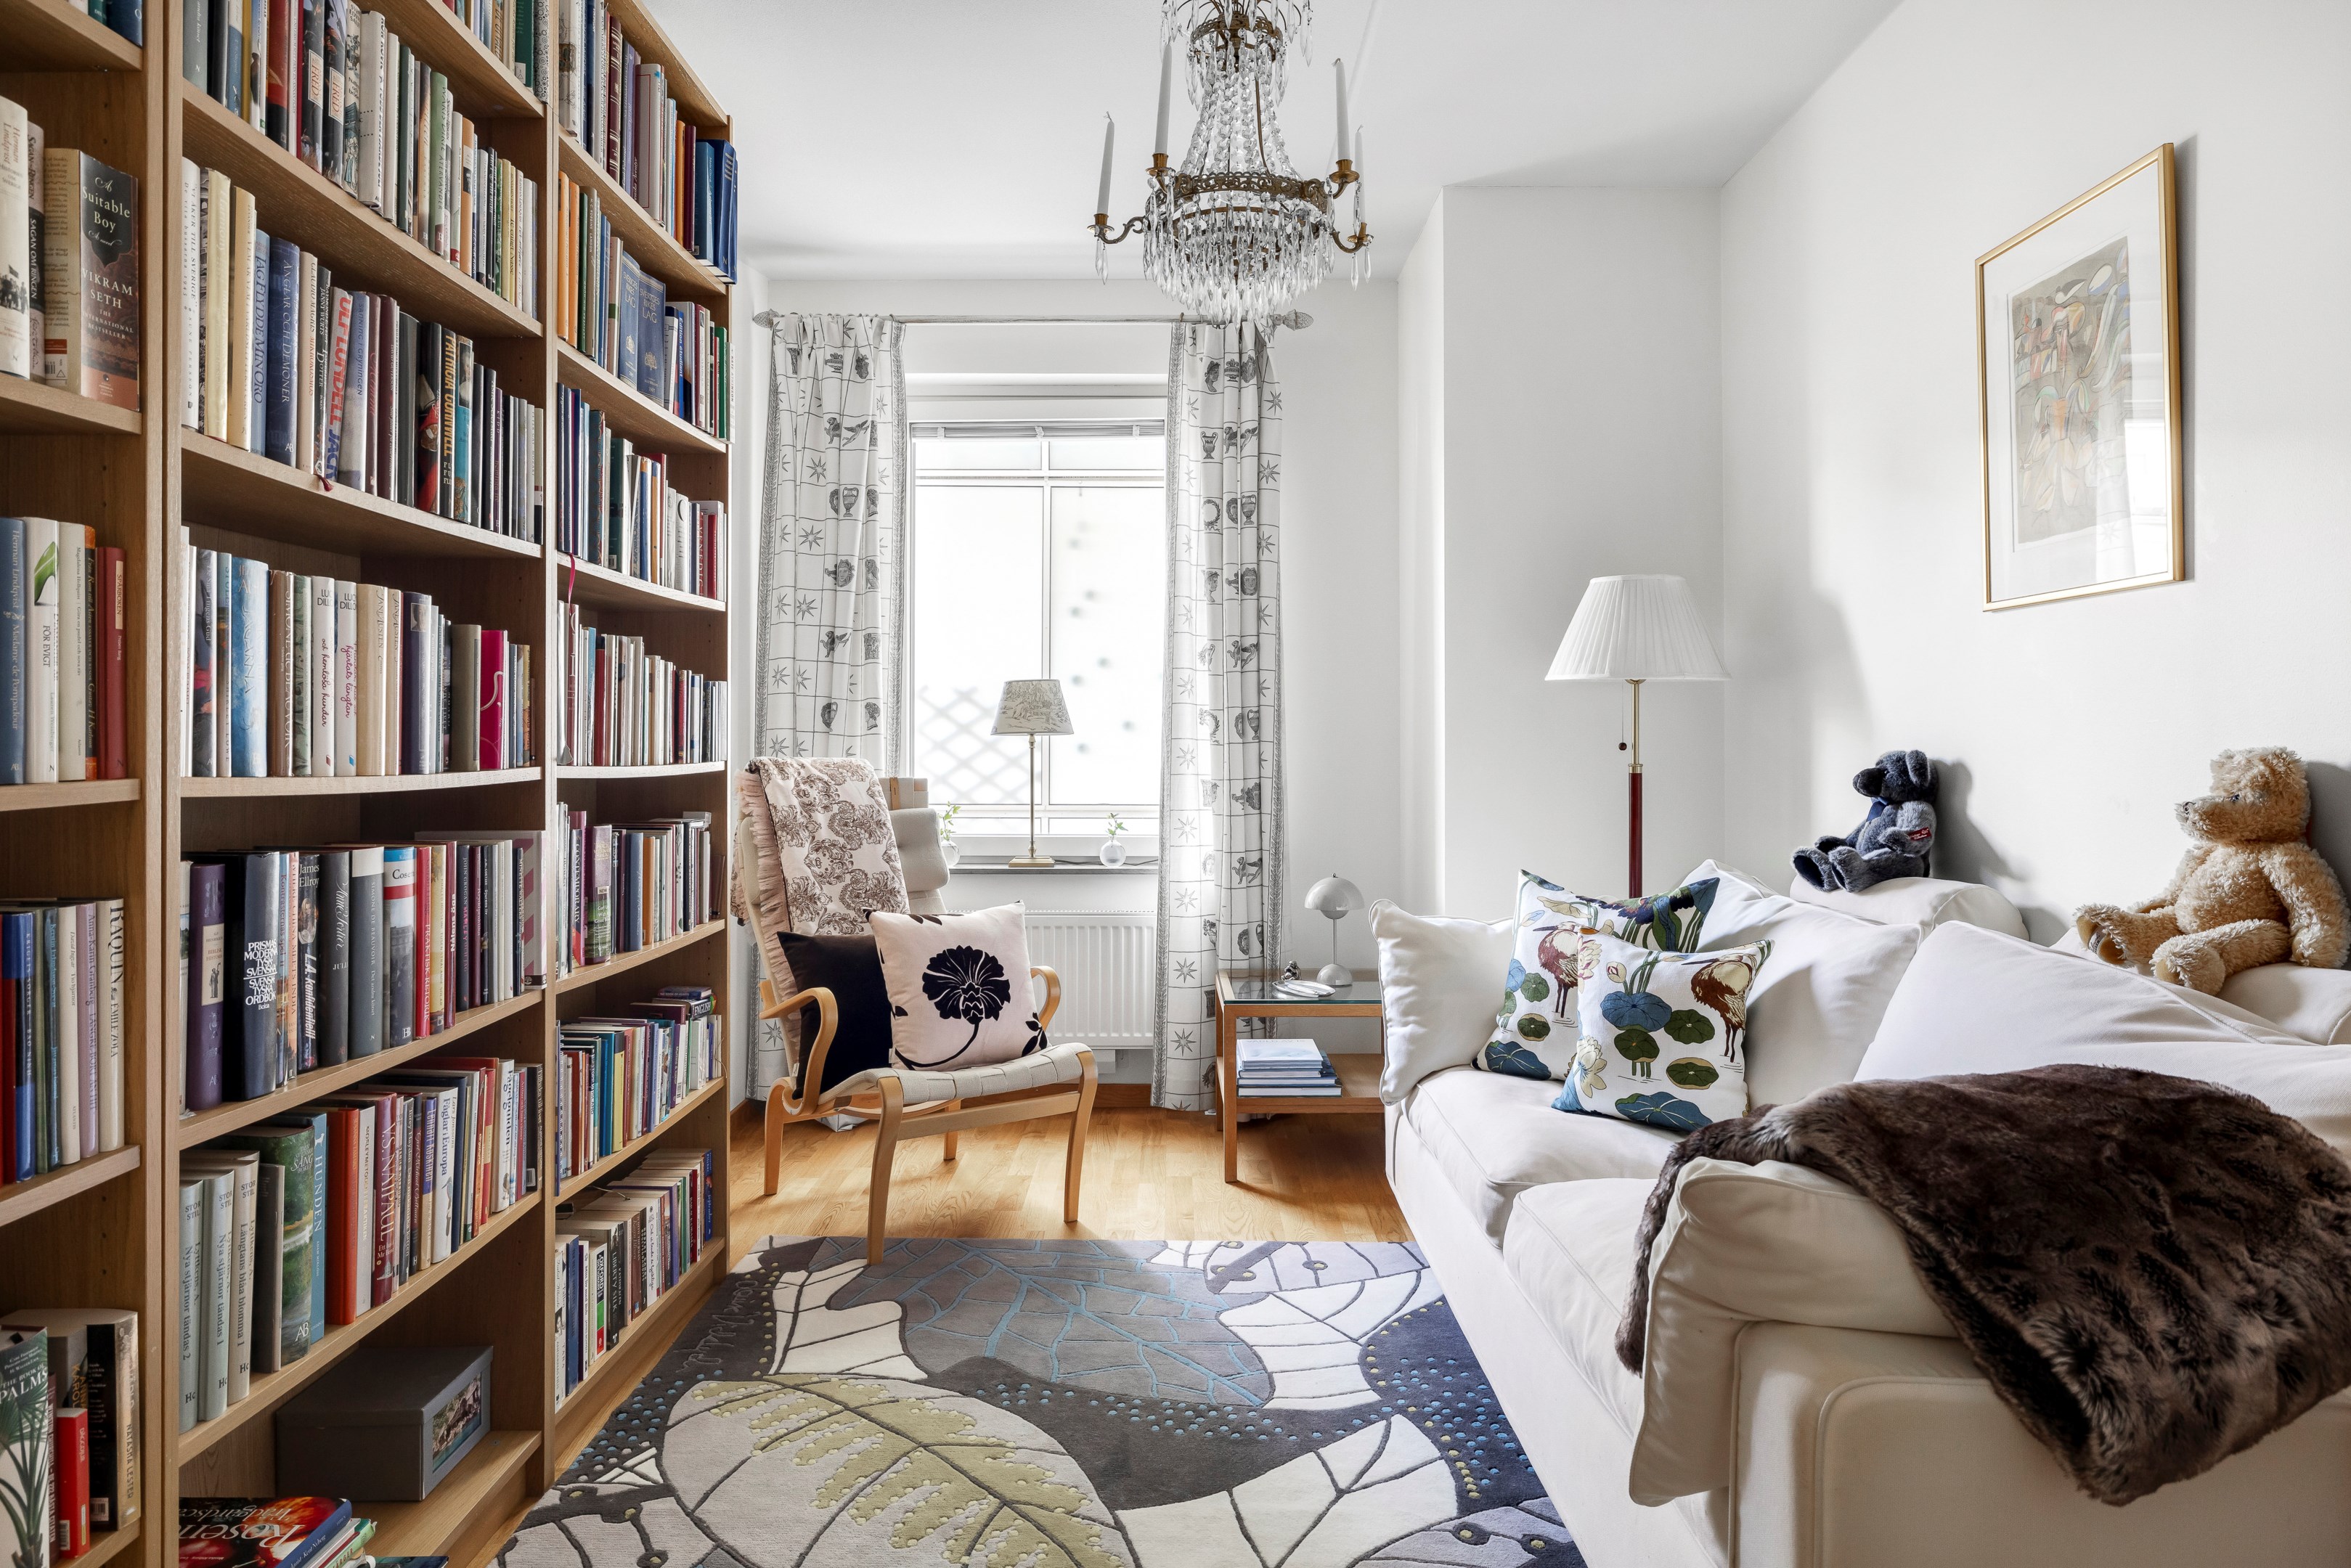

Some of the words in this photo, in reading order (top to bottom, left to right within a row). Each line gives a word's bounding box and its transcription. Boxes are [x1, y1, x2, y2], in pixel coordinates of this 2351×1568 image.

[332, 81, 341, 112] FRED
[1, 123, 12, 163] Lindqvist
[184, 182, 189, 192] De
[82, 187, 131, 219] Suitable
[94, 212, 115, 233] Boy
[30, 250, 37, 266] OM
[256, 256, 266, 281] JAG
[82, 268, 133, 295] VIKRAM
[90, 288, 122, 309] SETH
[255, 281, 265, 337] FLYDDE
[81, 310, 134, 333] INTERNATIONAL
[282, 312, 291, 340] OCH
[338, 297, 351, 335] ULF
[642, 307, 657, 323] LAG
[88, 323, 126, 339] BESTSELLER
[255, 339, 264, 373] MIN
[445, 335, 456, 388] PATRICIA
[282, 343, 292, 402] DEMONER
[329, 336, 347, 425] LUNDELL
[254, 373, 264, 403] ORO
[444, 393, 456, 457] CORNWELL
[10, 568, 20, 608] Lindqvist
[42, 625, 52, 642] FÖR
[42, 644, 51, 668] EVIGT
[341, 645, 354, 679] hjärtats
[12, 666, 20, 676] de
[10, 679, 20, 730] Pompadour
[341, 682, 354, 718] längtan
[299, 864, 319, 874] James
[299, 877, 319, 889] Ellroy
[371, 915, 375, 925] DE
[244, 948, 278, 960] MODERNA
[248, 939, 277, 951] PRISMAS
[246, 964, 276, 977] SVENSKA
[305, 953, 316, 973] L.A.
[245, 991, 276, 1005] ORDBOK
[253, 985, 273, 995] TYSKA
[110, 1003, 119, 1034] ÉMILE
[441, 1098, 452, 1132] Fåglar
[440, 1137, 450, 1176] Europa
[219, 1191, 232, 1201] STOR
[241, 1180, 256, 1191] STOR
[243, 1189, 255, 1198] STIL
[314, 1155, 324, 1232] HUNDEN
[380, 1153, 395, 1241] NAIPAUL
[185, 1201, 201, 1213] STOR
[187, 1211, 200, 1220] STIL
[221, 1200, 232, 1209] STIL
[183, 1246, 192, 1267] Nya
[216, 1234, 226, 1256] Nya
[237, 1222, 248, 1270] Längtans
[215, 1257, 227, 1300] stjärnor
[237, 1273, 248, 1295] blåa
[182, 1270, 192, 1312] stjärnor
[216, 1302, 225, 1337] tändas
[237, 1297, 247, 1337] blomma
[182, 1315, 192, 1349] tändas
[295, 1322, 309, 1342] AB
[0, 1366, 48, 1404] PALMS
[1, 1379, 17, 1389] THE
[19, 1368, 36, 1381] BOOK
